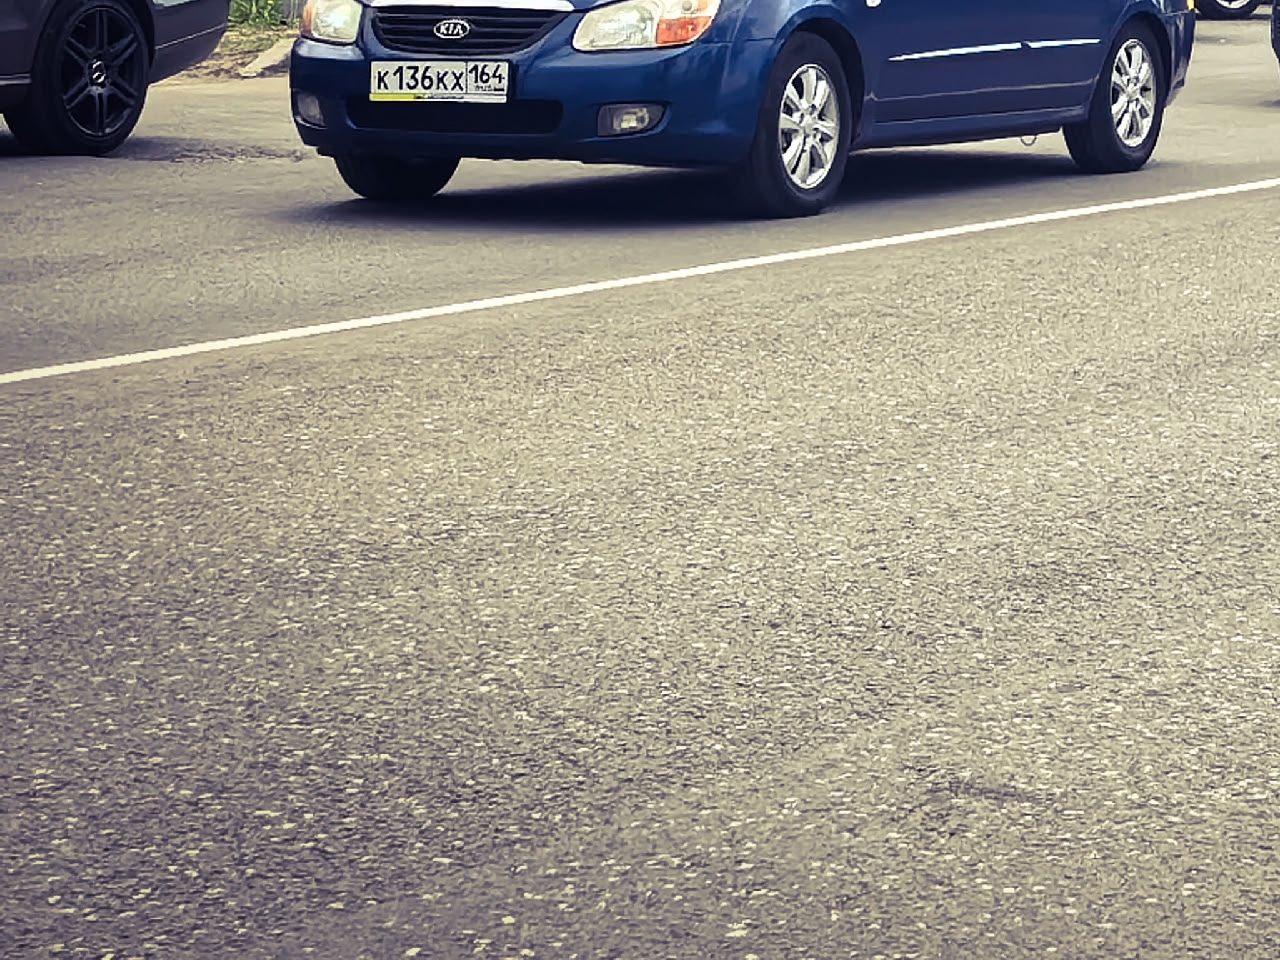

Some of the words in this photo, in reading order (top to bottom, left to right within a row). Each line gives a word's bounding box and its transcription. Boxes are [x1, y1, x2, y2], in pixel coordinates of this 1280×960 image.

[440, 23, 463, 35] KIA
[377, 65, 464, 91] К136КХ
[468, 64, 502, 84] 164
